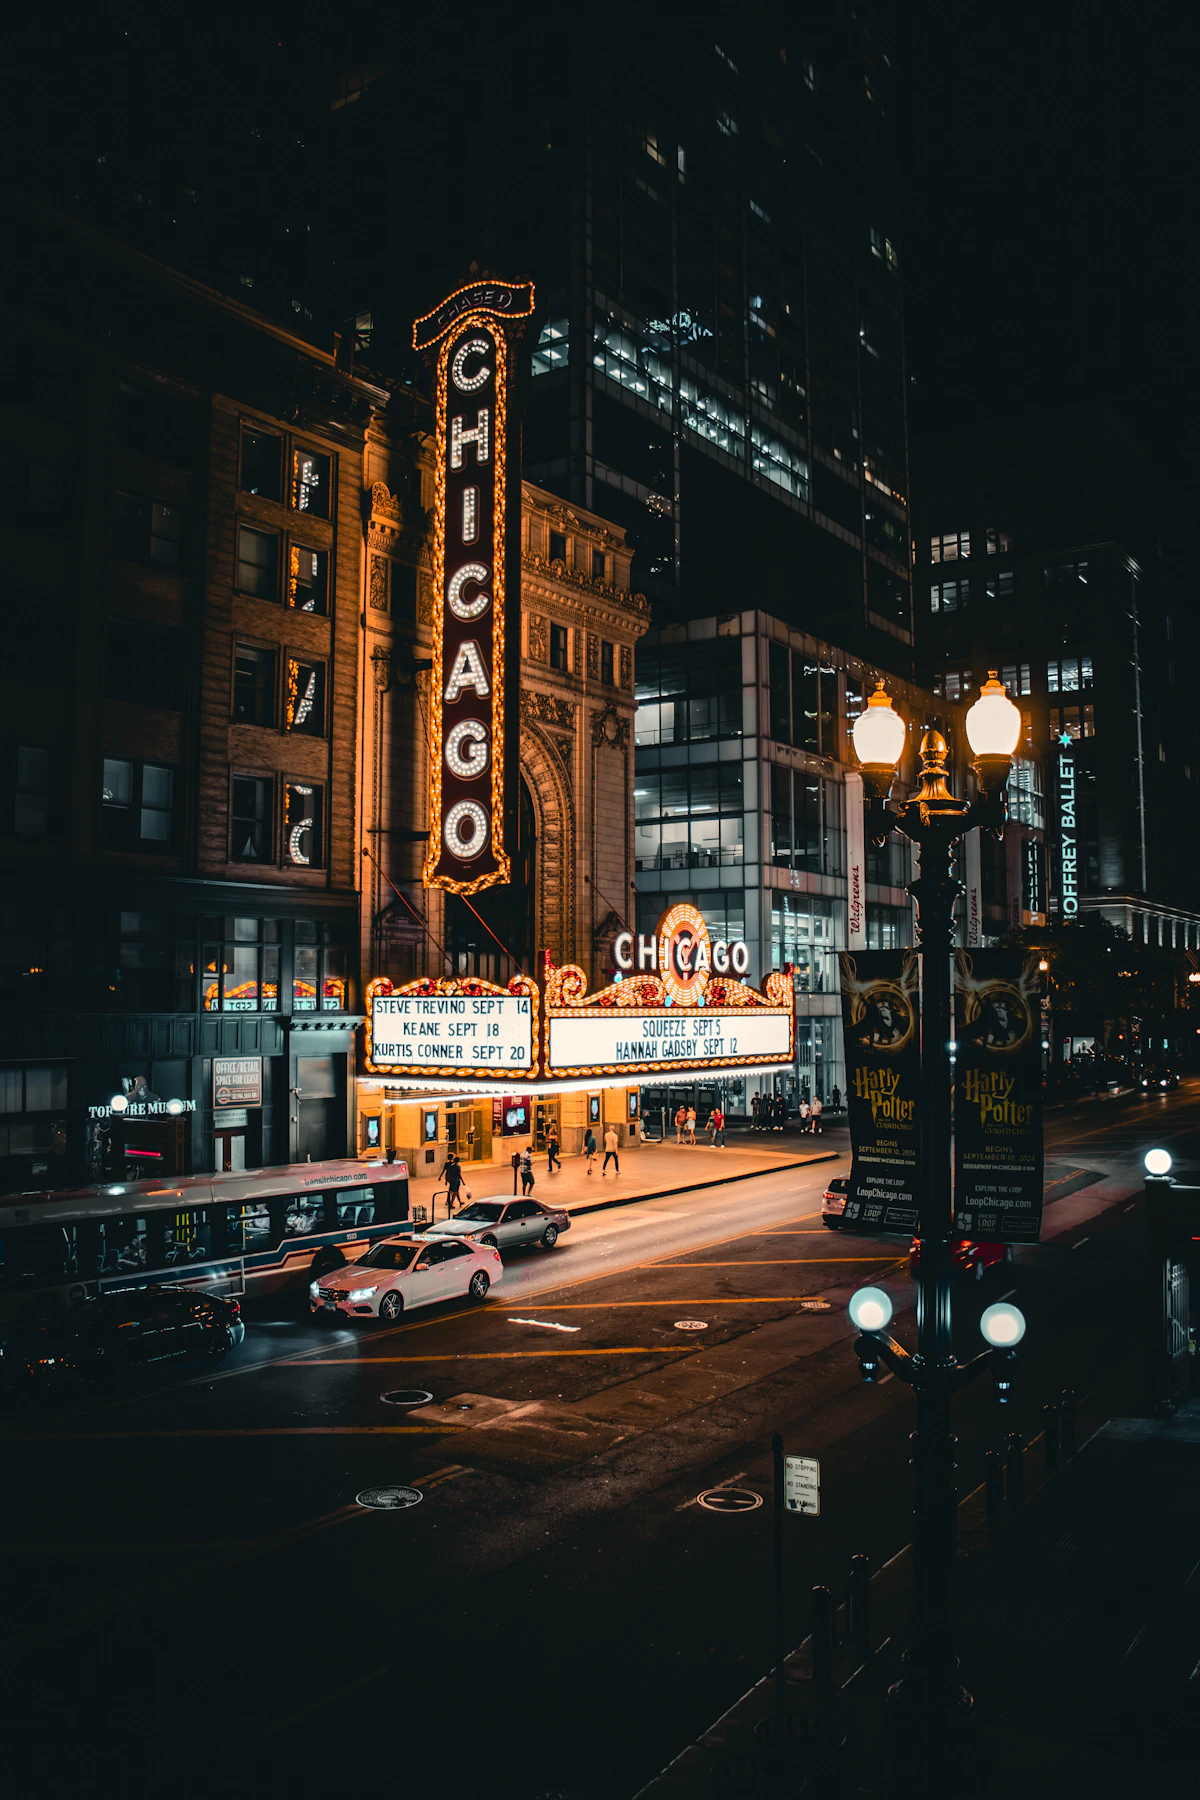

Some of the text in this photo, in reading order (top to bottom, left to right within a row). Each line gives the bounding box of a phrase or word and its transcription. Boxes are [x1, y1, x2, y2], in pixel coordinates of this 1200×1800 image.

[444, 339, 491, 859] CHICAGO
[1059, 754, 1078, 920] OFFREY BALLET
[850, 865, 864, 935] Walgreens
[968, 887, 980, 946] Walgreens
[613, 932, 749, 974] CHICAGO
[376, 1000, 529, 1015] STEVE TREVINO SEPT 14
[403, 1022, 500, 1037] KEANE SEPT 18
[642, 1019, 721, 1038] SQUEEZE SEPT 5
[374, 1043, 525, 1060] KURTIS CONNER SEPT 20
[616, 1037, 738, 1061] HANNAH GADSBY SEPT 12
[216, 1061, 259, 1074] OFFICE/RETAIL
[216, 1074, 259, 1086] SPACE FOR LEASE
[851, 1065, 901, 1100] Harry
[961, 1068, 1015, 1103] Harry
[88, 1099, 197, 1118] TORURE MUUM
[869, 1090, 915, 1124] Potter
[980, 1093, 1033, 1128] Potter
[858, 1145, 892, 1155] SEPTEMBER
[876, 1139, 898, 1147] BEGINS
[985, 1145, 1013, 1153] BEGINS
[962, 1152, 1006, 1161] SEPTEMBER
[1018, 1154, 1036, 1162] 2024
[866, 1176, 885, 1185] EXPLORE
[893, 1179, 905, 1187] LOOP
[998, 1185, 1008, 1193] THE
[856, 1186, 913, 1202] LoopChicago.com
[965, 1195, 1032, 1210] LoopChicago.com
[863, 1209, 882, 1218] LOOP
[977, 1219, 997, 1227] LOOP
[795, 1464, 816, 1473] STOPPING
[795, 1481, 816, 1490] STANDING
